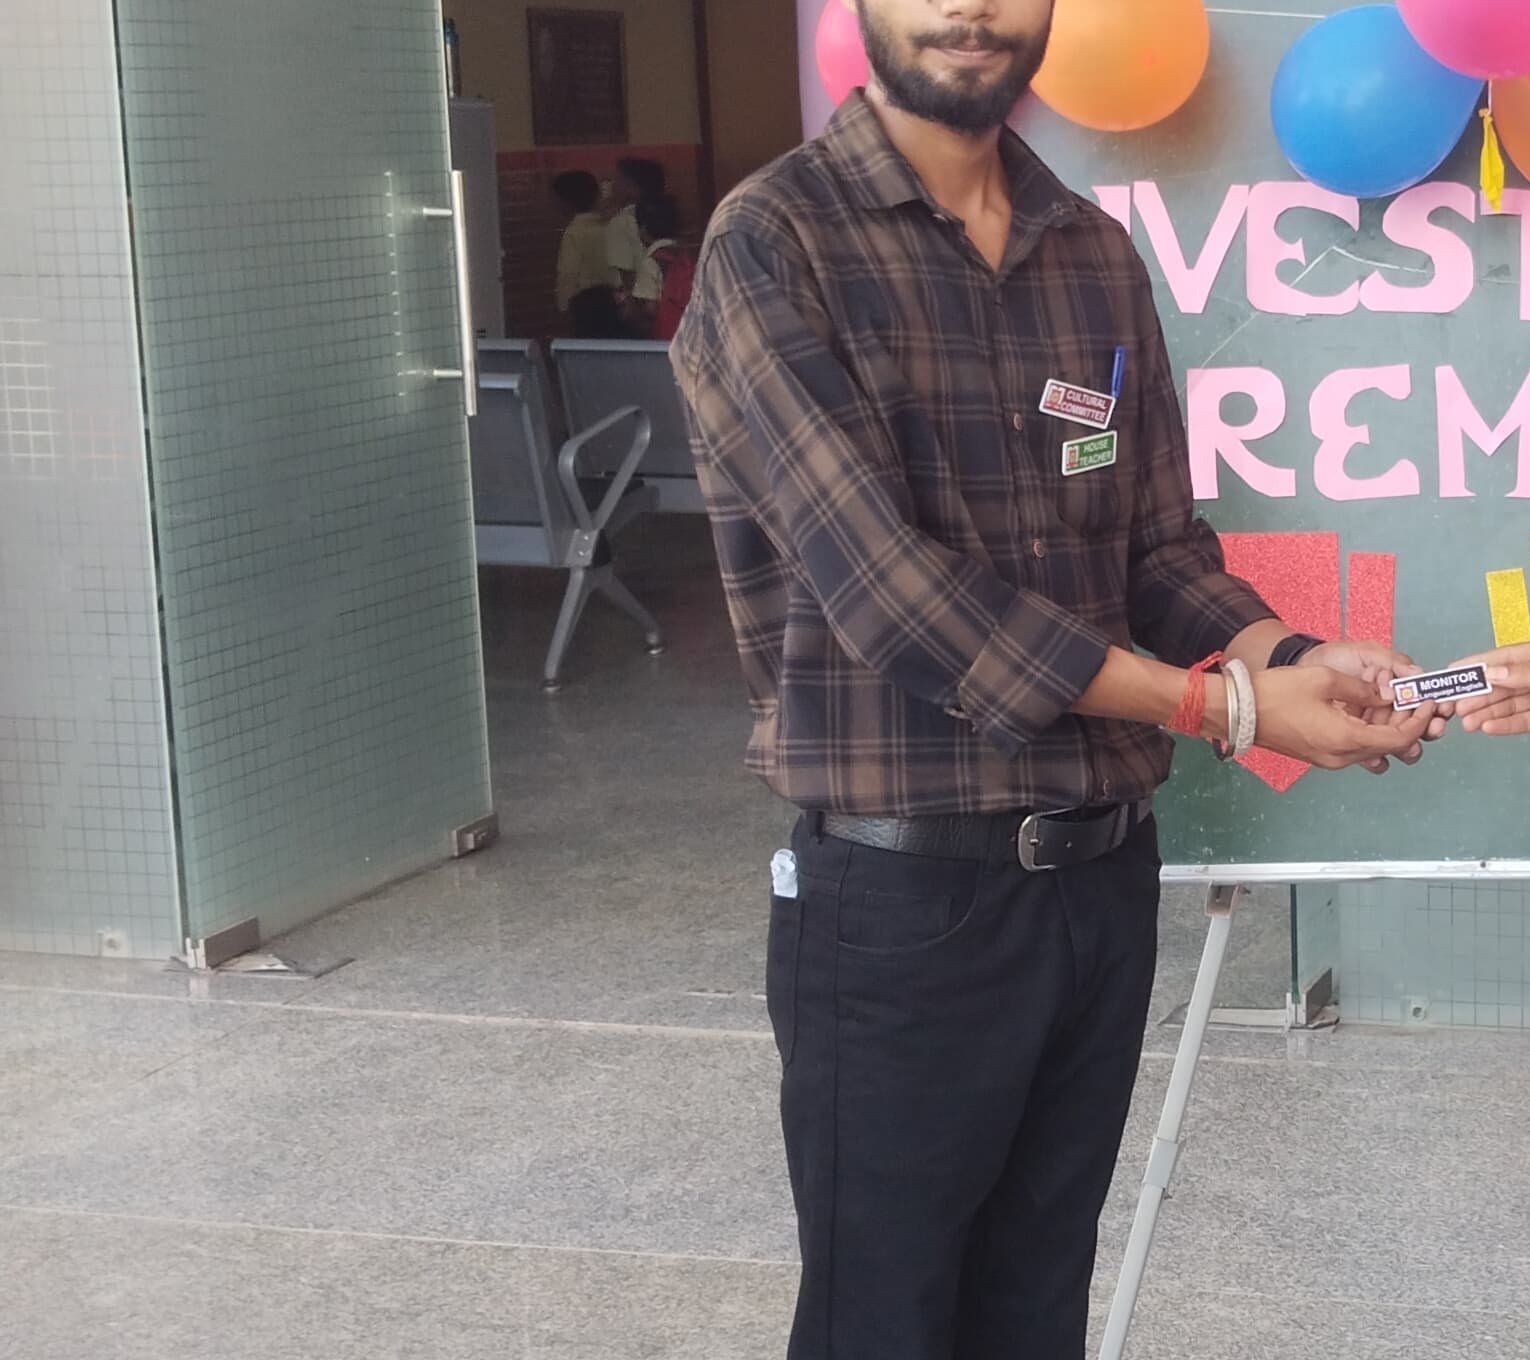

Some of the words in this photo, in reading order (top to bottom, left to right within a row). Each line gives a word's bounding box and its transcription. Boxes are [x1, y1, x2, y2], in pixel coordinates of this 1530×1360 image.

[1066, 390, 1108, 409] CULTURAL
[1061, 402, 1107, 422] COMMITTEE
[1083, 438, 1109, 453] HOUSE
[1079, 450, 1113, 466] TEACHER
[1419, 671, 1479, 691] MONITOR
[1419, 688, 1455, 700] Language
[1455, 682, 1484, 693] English
